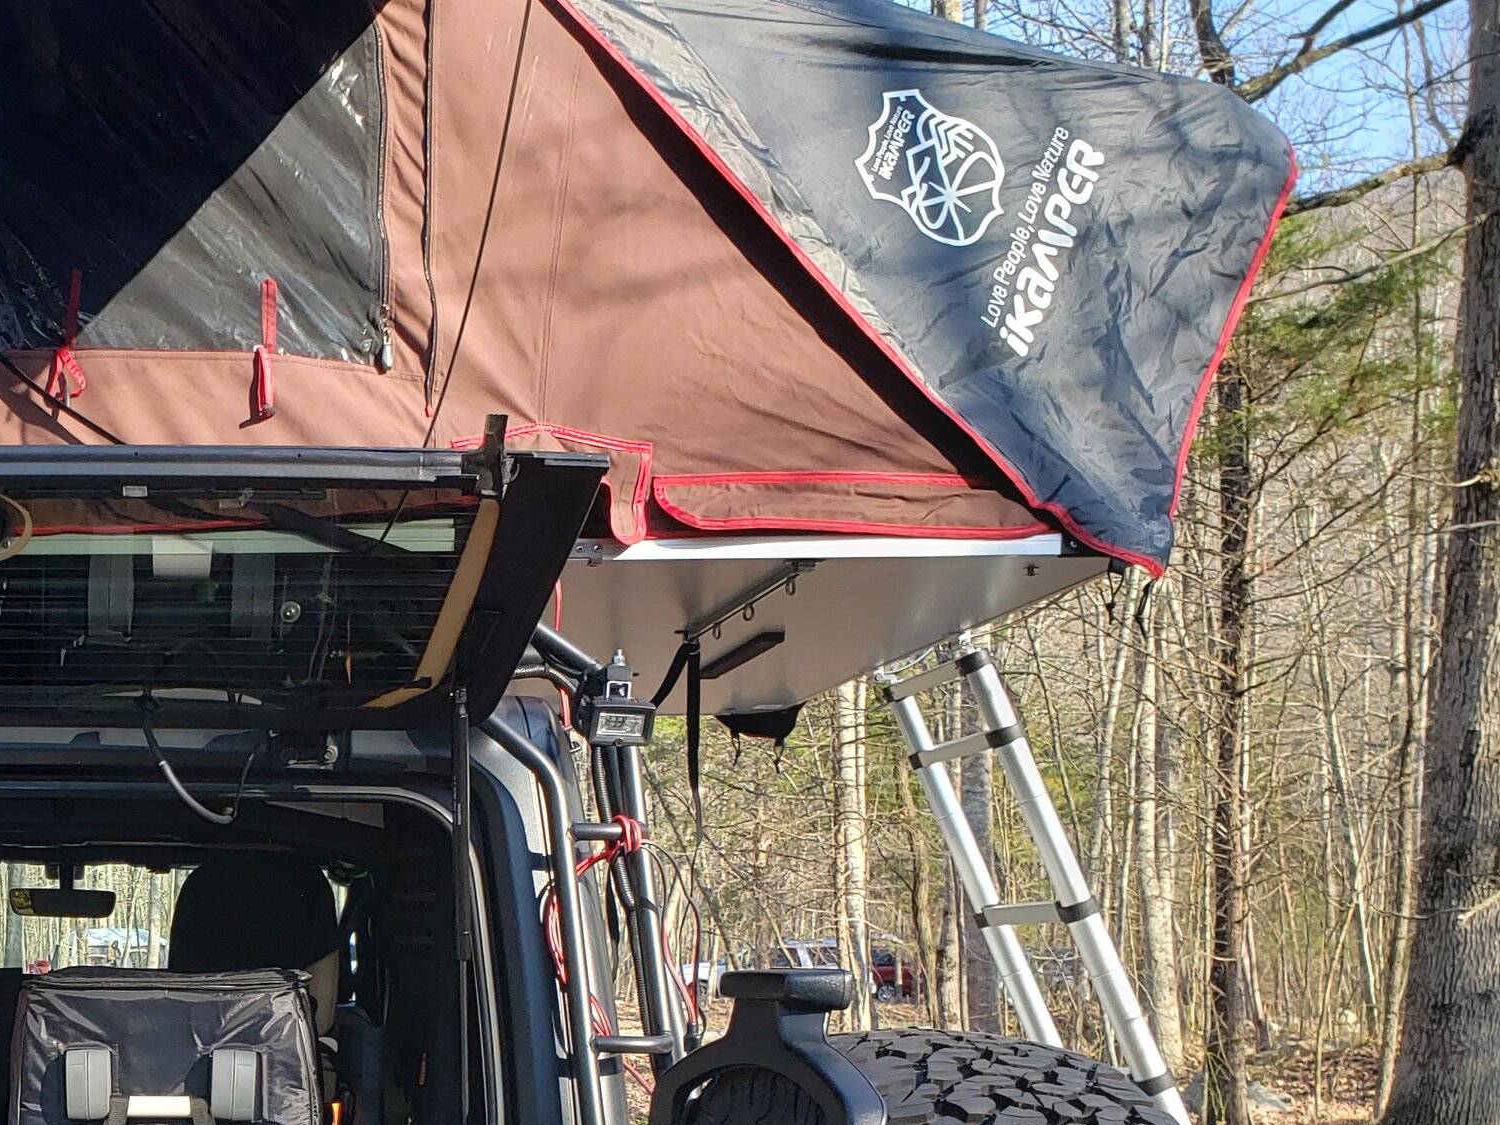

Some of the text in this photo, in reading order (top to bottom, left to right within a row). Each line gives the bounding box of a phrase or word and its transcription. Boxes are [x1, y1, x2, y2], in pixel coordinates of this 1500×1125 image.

[981, 126, 1070, 329] Love People, Love Nature
